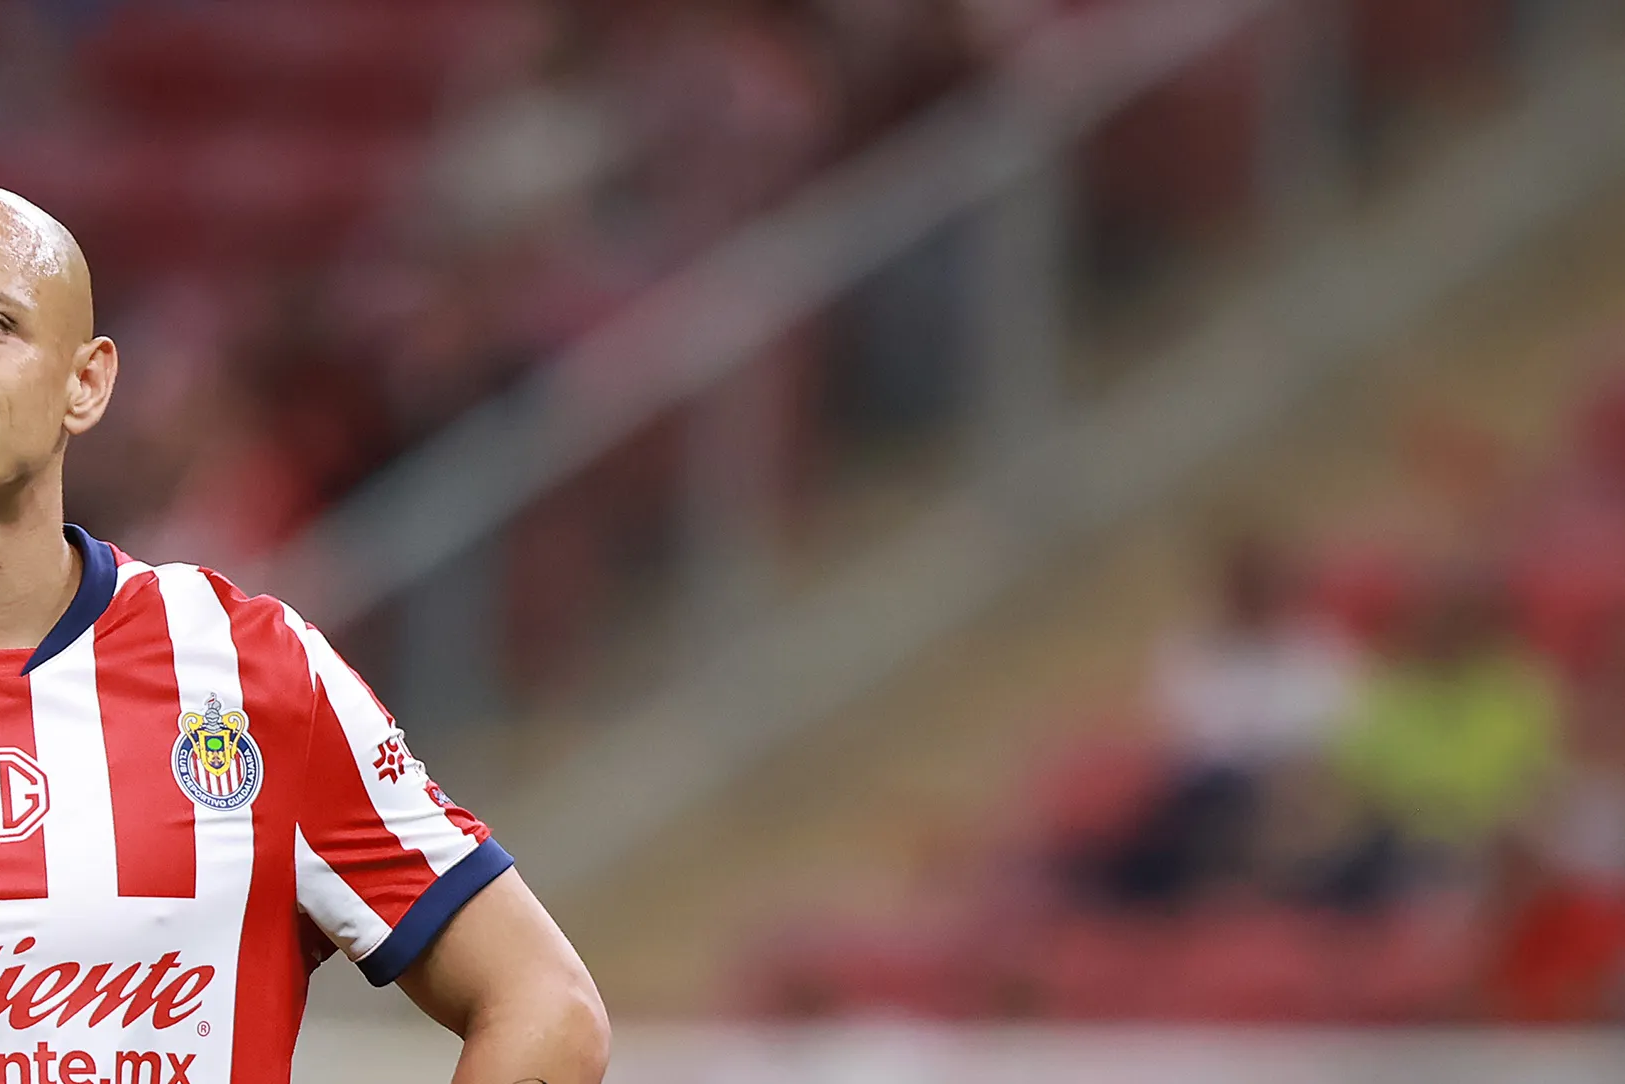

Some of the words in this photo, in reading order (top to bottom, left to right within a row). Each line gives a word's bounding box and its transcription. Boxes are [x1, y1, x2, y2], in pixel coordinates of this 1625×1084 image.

[179, 748, 188, 773] CLUB
[183, 774, 226, 807] DEPORTIVO
[227, 748, 255, 807] GUADALAJARA
